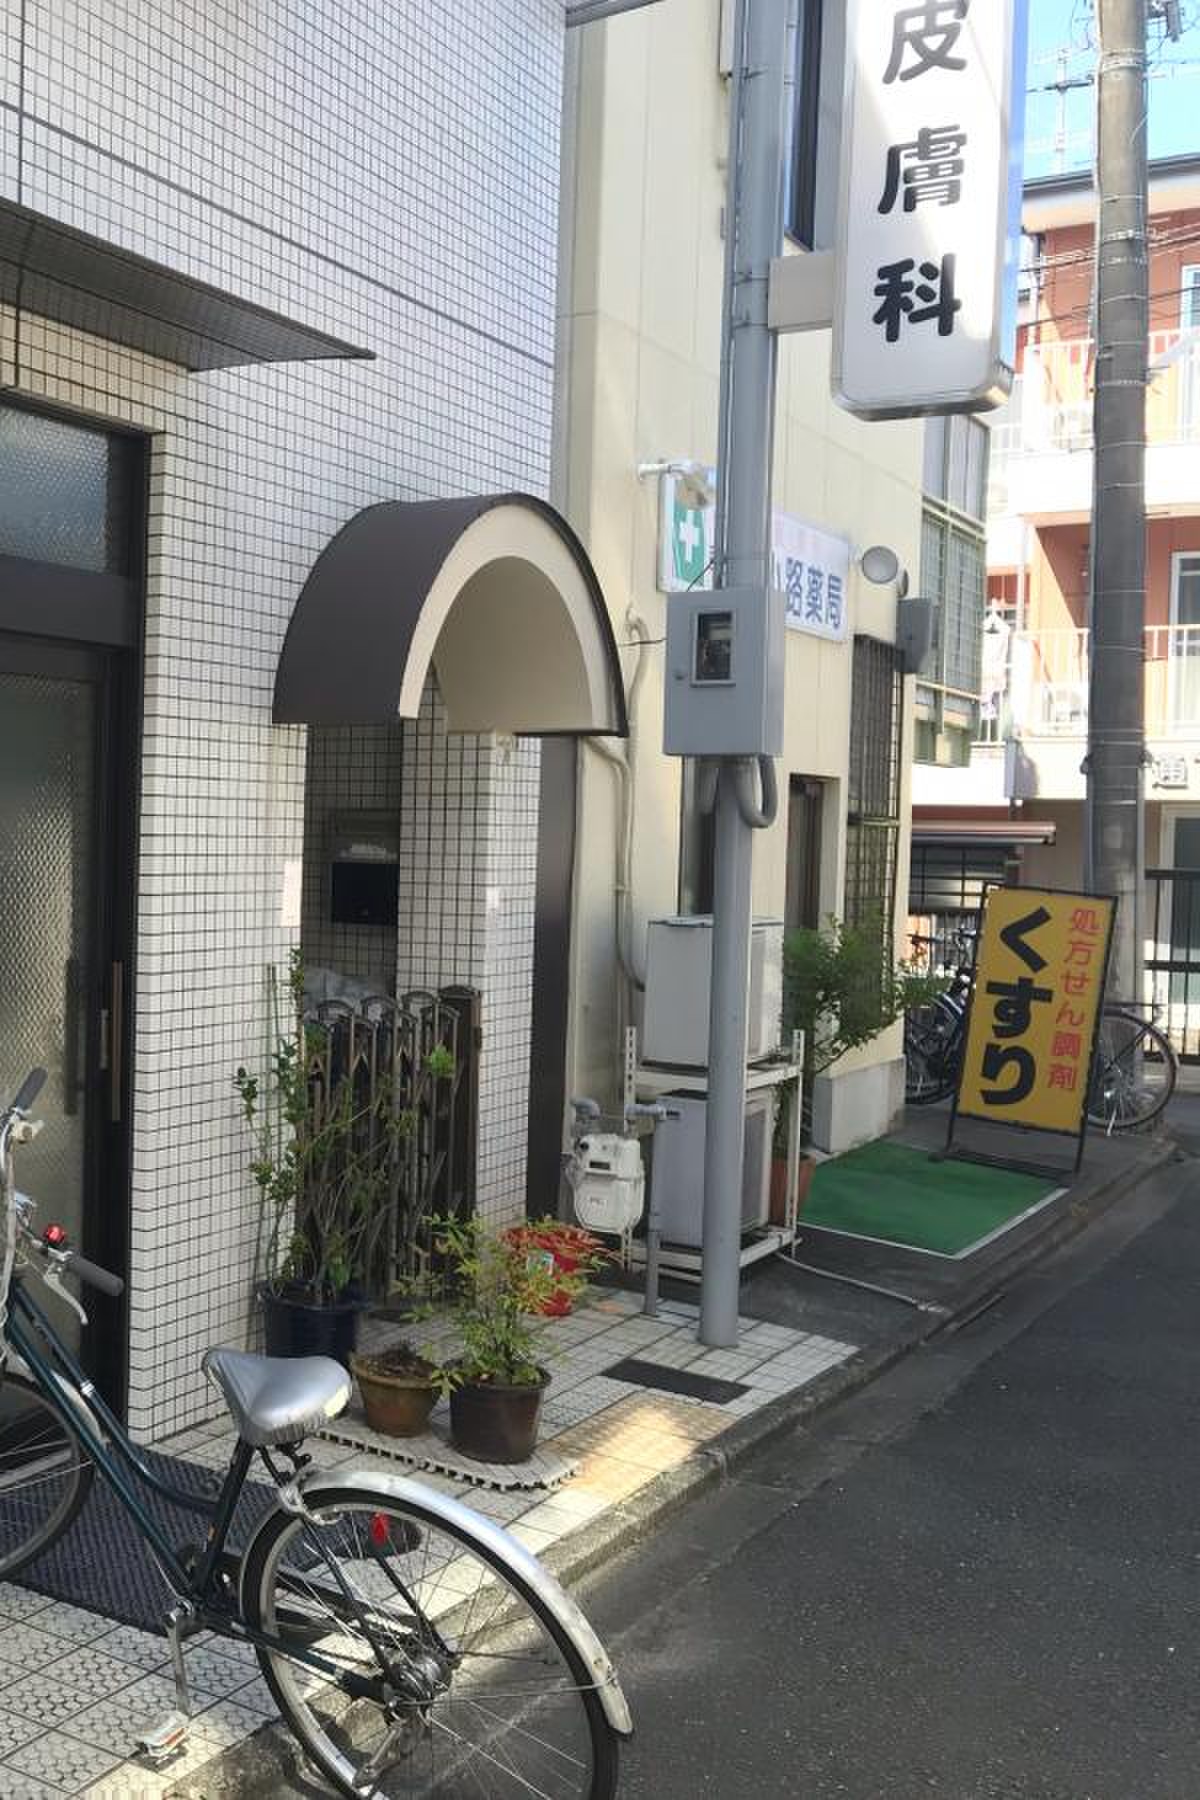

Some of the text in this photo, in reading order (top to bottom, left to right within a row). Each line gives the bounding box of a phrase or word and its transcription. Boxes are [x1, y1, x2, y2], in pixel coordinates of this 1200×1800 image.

[873, 0, 969, 342] 皮膚科
[980, 906, 1053, 1105] くすり
